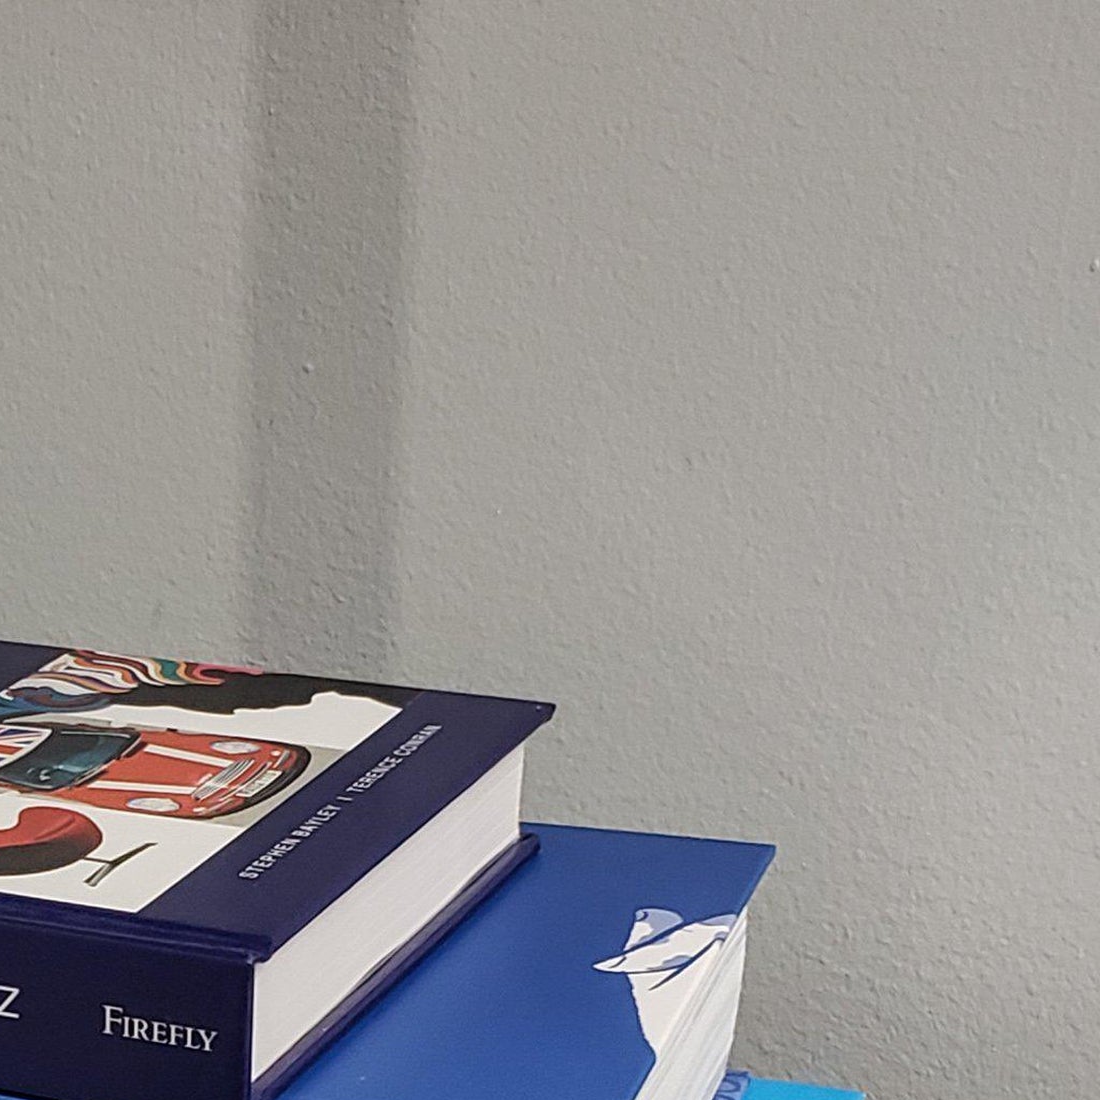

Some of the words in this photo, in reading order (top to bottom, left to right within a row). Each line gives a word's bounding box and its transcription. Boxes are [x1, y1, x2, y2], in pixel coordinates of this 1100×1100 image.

[239, 837, 300, 880] STEPHEN
[292, 803, 342, 838] BAYLEY
[346, 756, 402, 793] TERENCE
[393, 724, 442, 758] CONRAN
